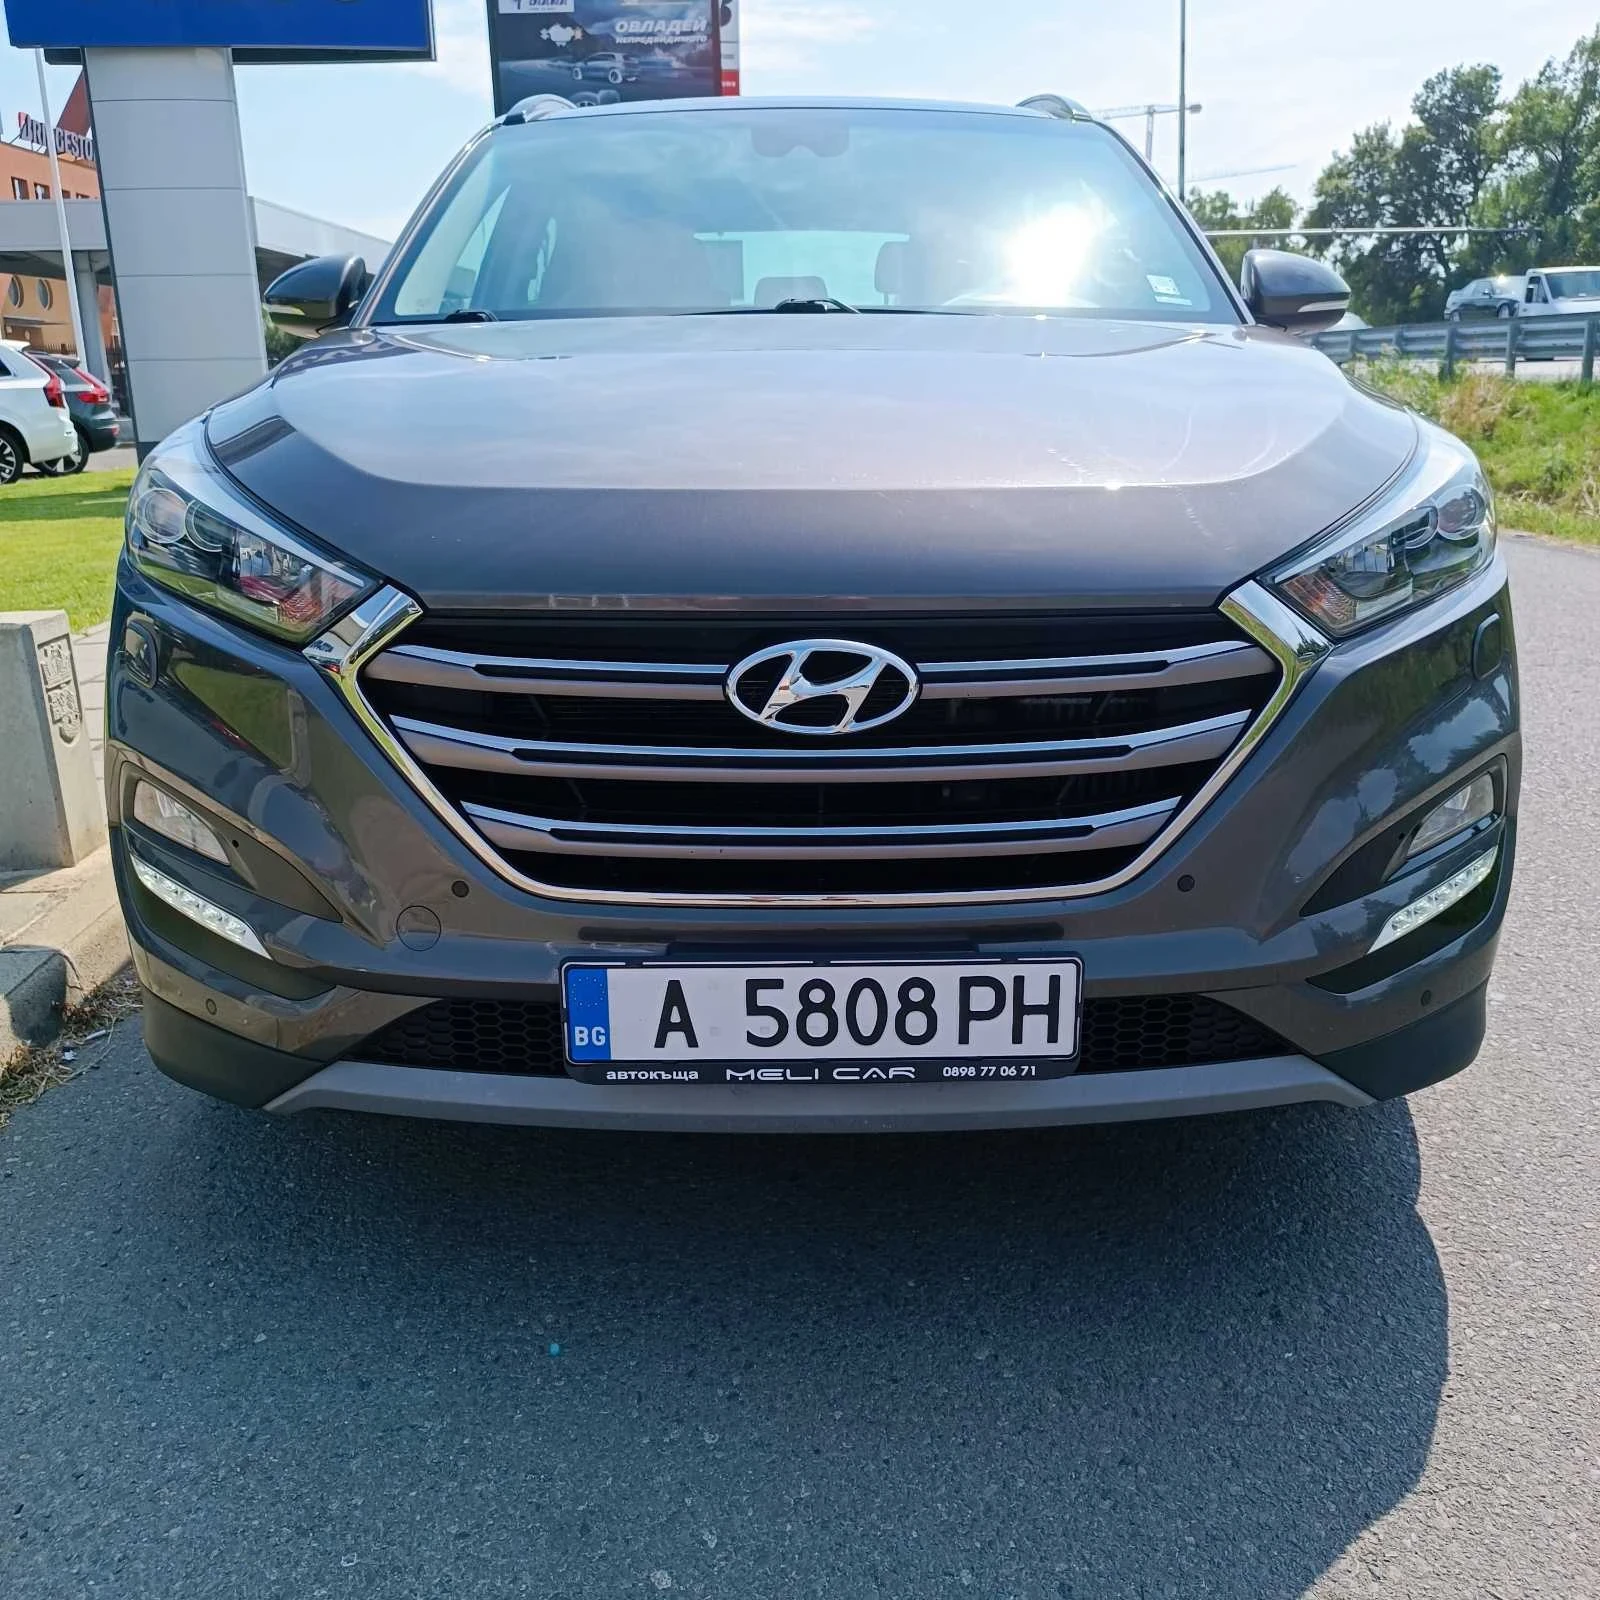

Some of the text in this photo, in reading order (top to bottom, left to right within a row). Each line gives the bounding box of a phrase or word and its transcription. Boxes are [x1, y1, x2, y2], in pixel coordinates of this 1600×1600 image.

[615, 17, 708, 34] ОВЛАДЕЙ
[654, 974, 1061, 1048] A 5808 PH
[574, 1026, 606, 1046] BG
[606, 1068, 699, 1080] автокъща
[726, 1067, 916, 1081] MELI CAR
[942, 1065, 1036, 1077] 0898 77 06 71
